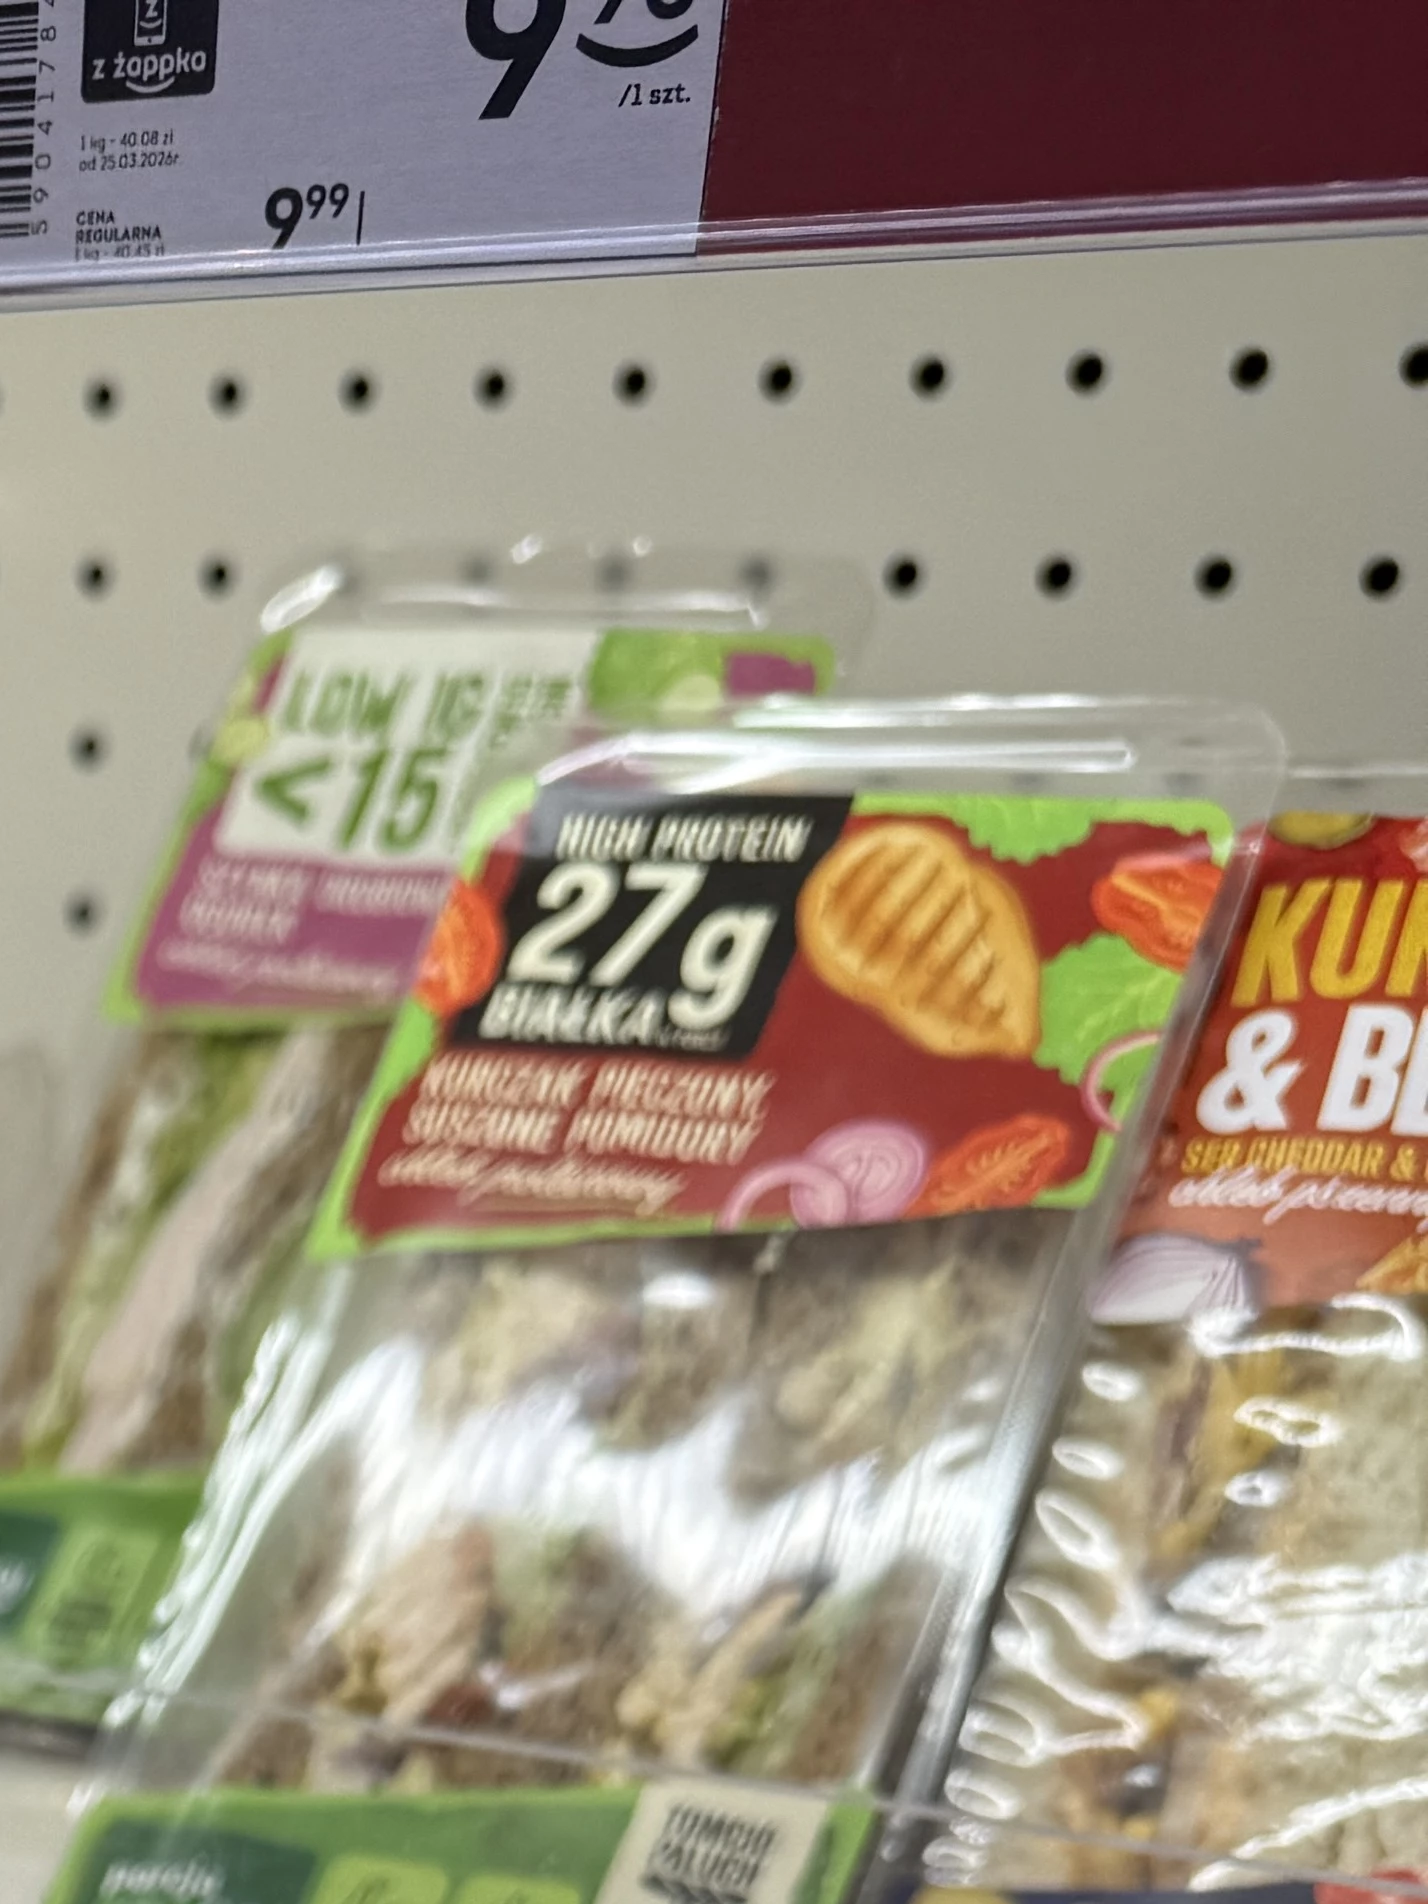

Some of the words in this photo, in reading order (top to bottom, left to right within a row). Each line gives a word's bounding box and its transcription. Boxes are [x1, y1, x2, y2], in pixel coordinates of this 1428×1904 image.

[75, 209, 115, 226] CENA
[75, 224, 162, 244] REGULARNA
[557, 813, 648, 861] HIGH
[650, 814, 815, 863] PROTEIN
[1196, 1008, 1307, 1135] &
